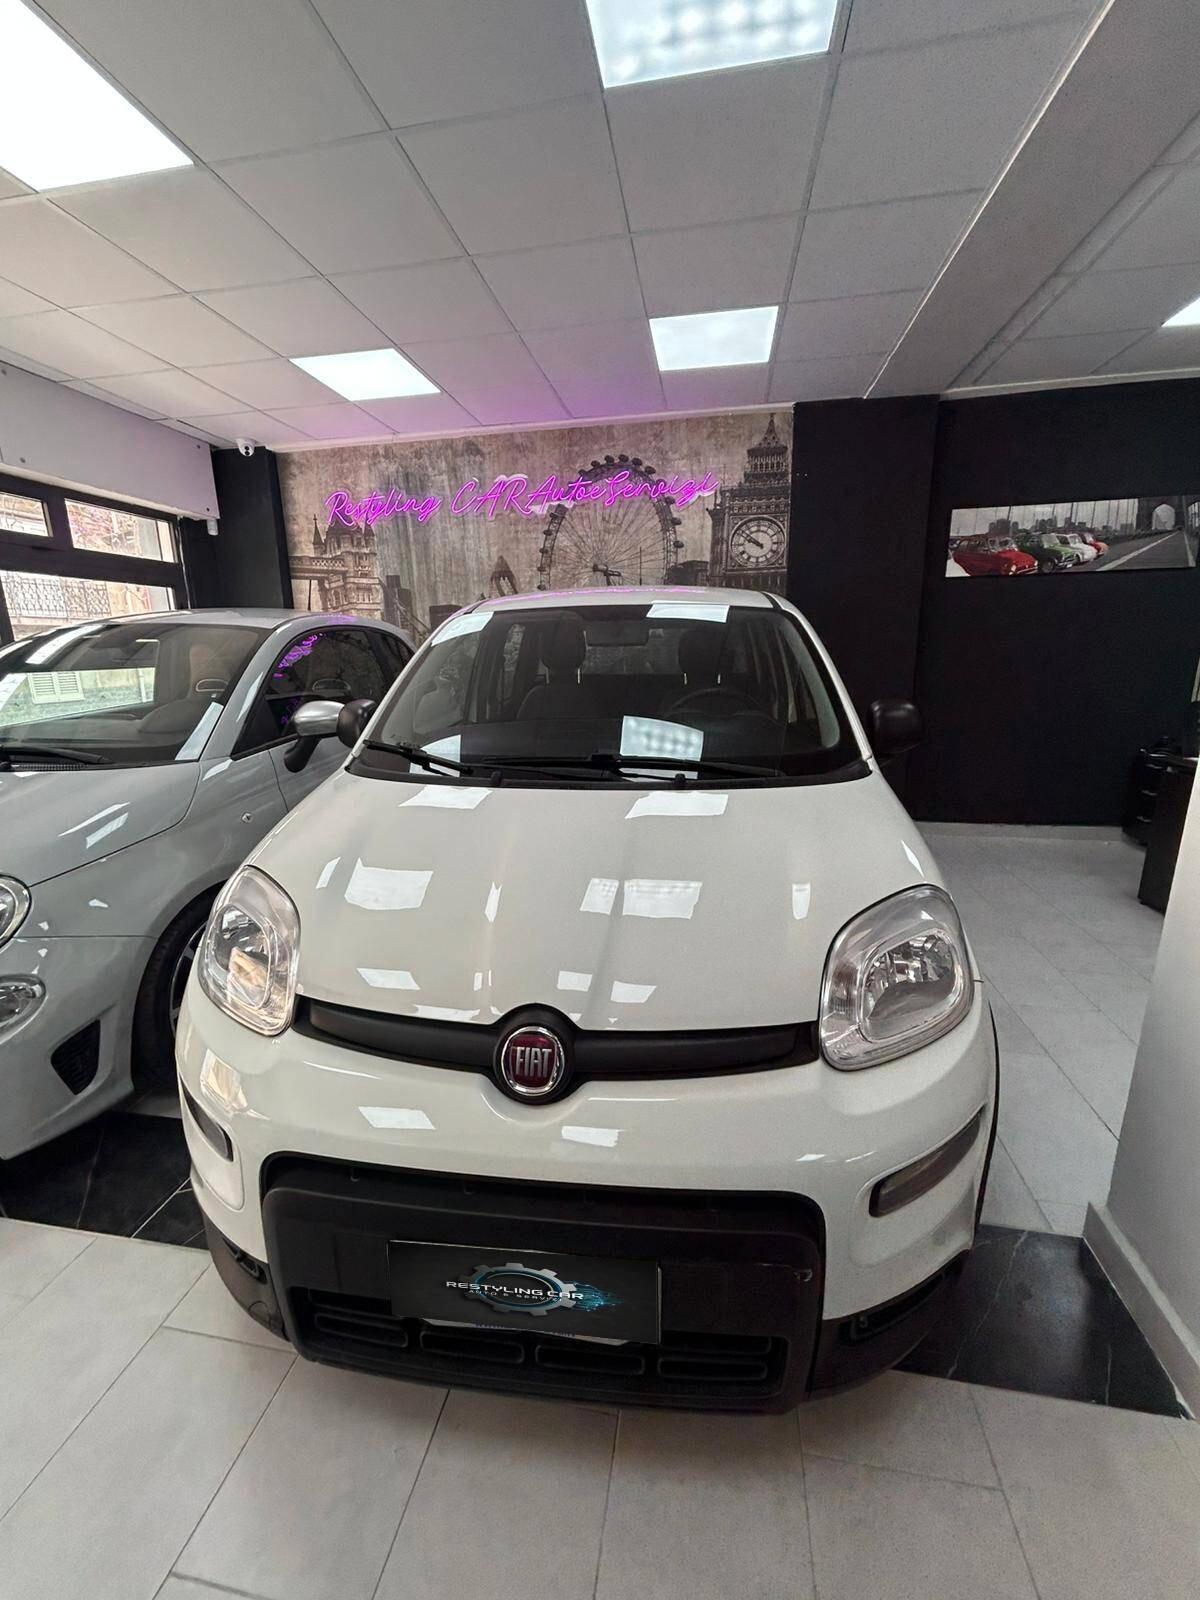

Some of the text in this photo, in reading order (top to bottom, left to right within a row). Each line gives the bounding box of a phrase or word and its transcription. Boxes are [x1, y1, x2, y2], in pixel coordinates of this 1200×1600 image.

[327, 490, 441, 525] Restyling
[451, 477, 531, 520] CAR
[516, 1047, 552, 1077] FIAT
[446, 1281, 584, 1300] RESTYLING CAR
